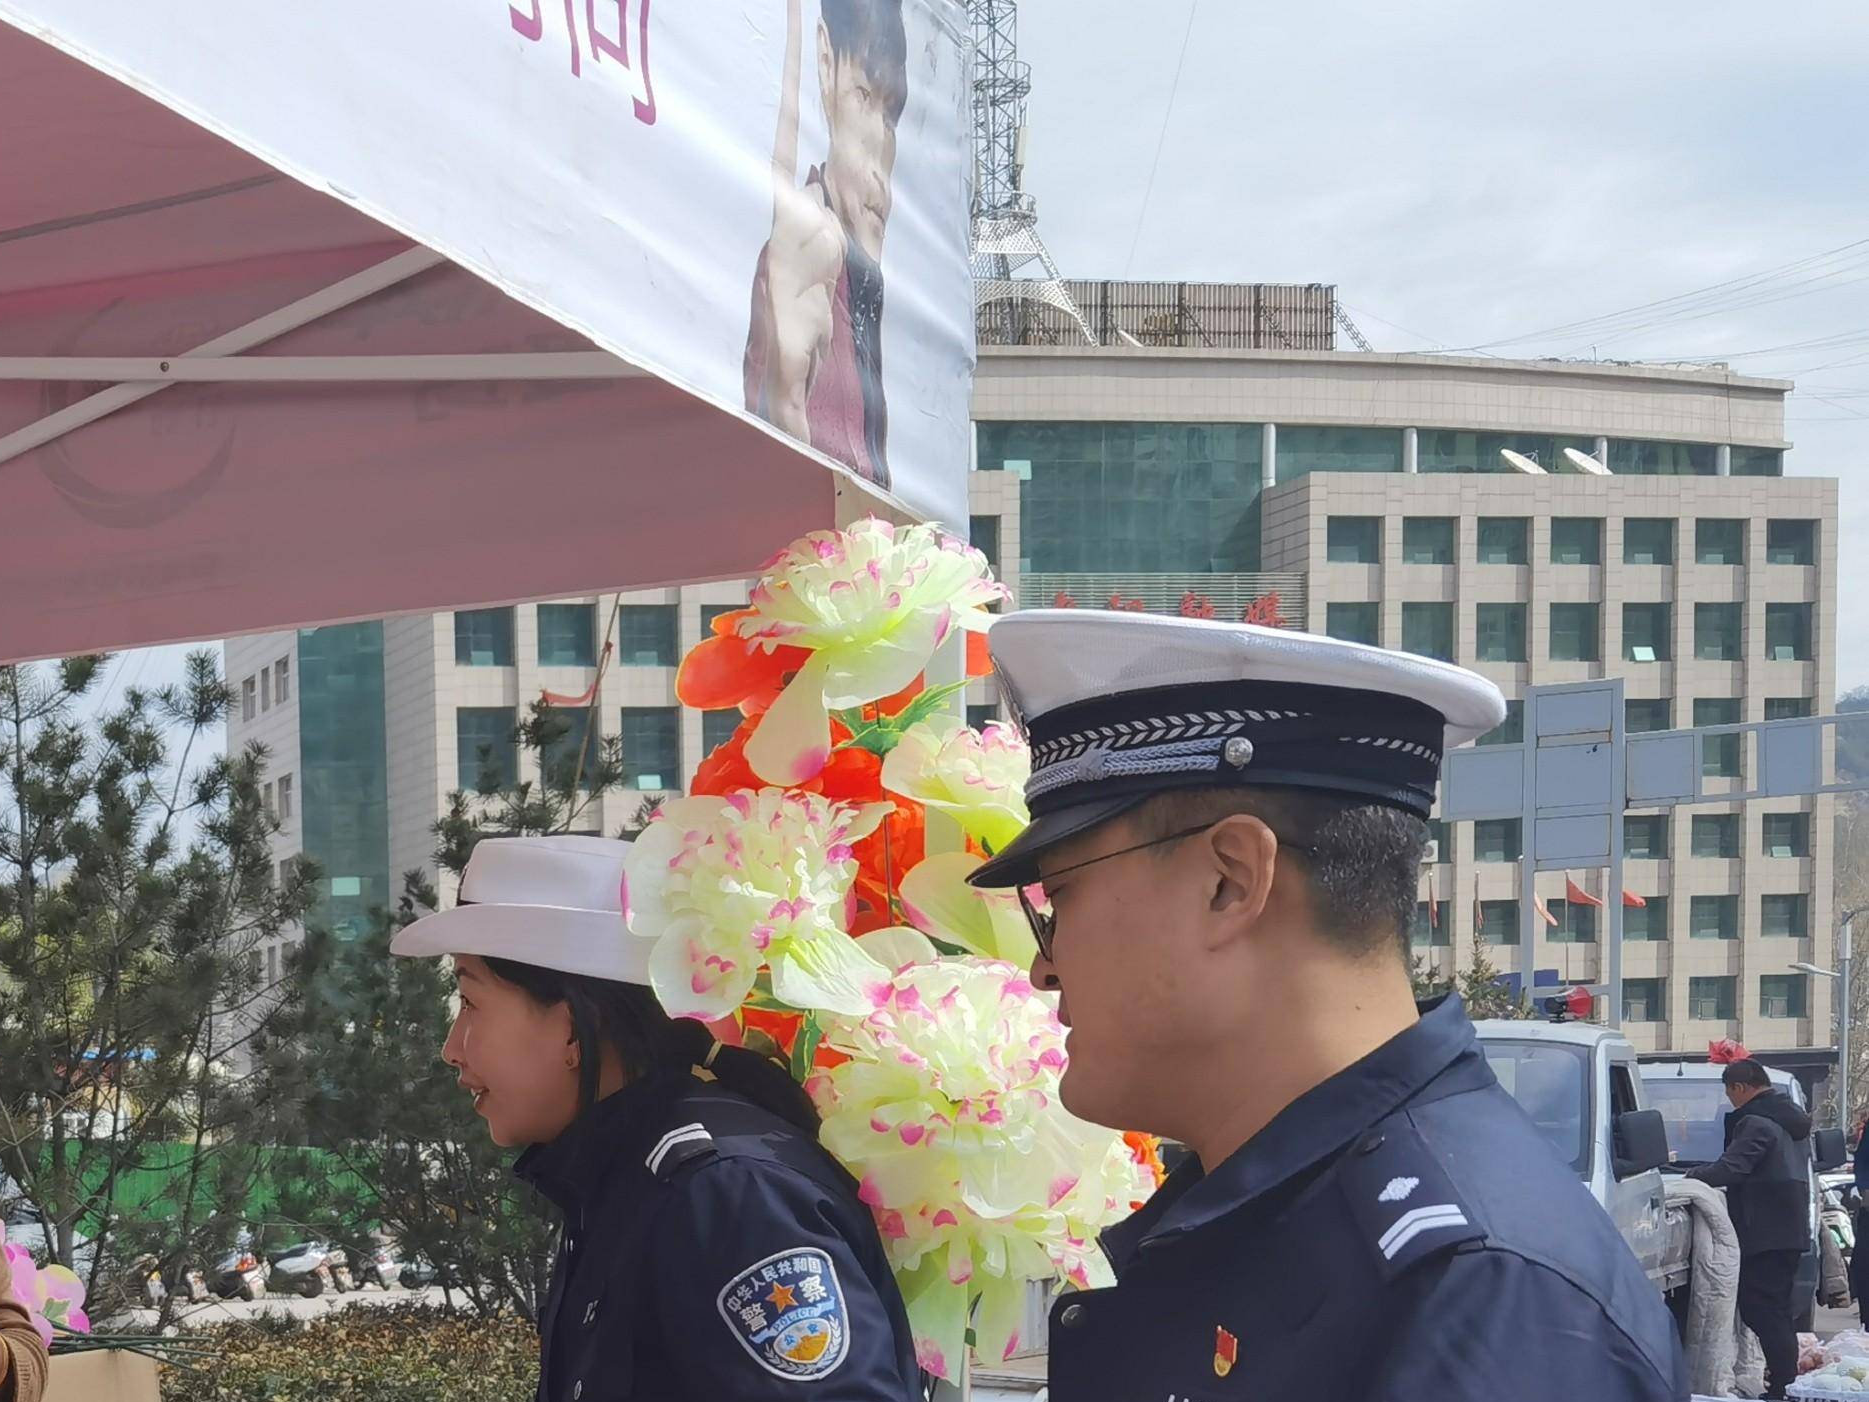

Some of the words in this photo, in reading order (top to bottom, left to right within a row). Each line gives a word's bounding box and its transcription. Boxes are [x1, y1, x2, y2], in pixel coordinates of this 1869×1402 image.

[727, 1256, 822, 1312] 中华人民共和国
[772, 1308, 817, 1333] POLICE
